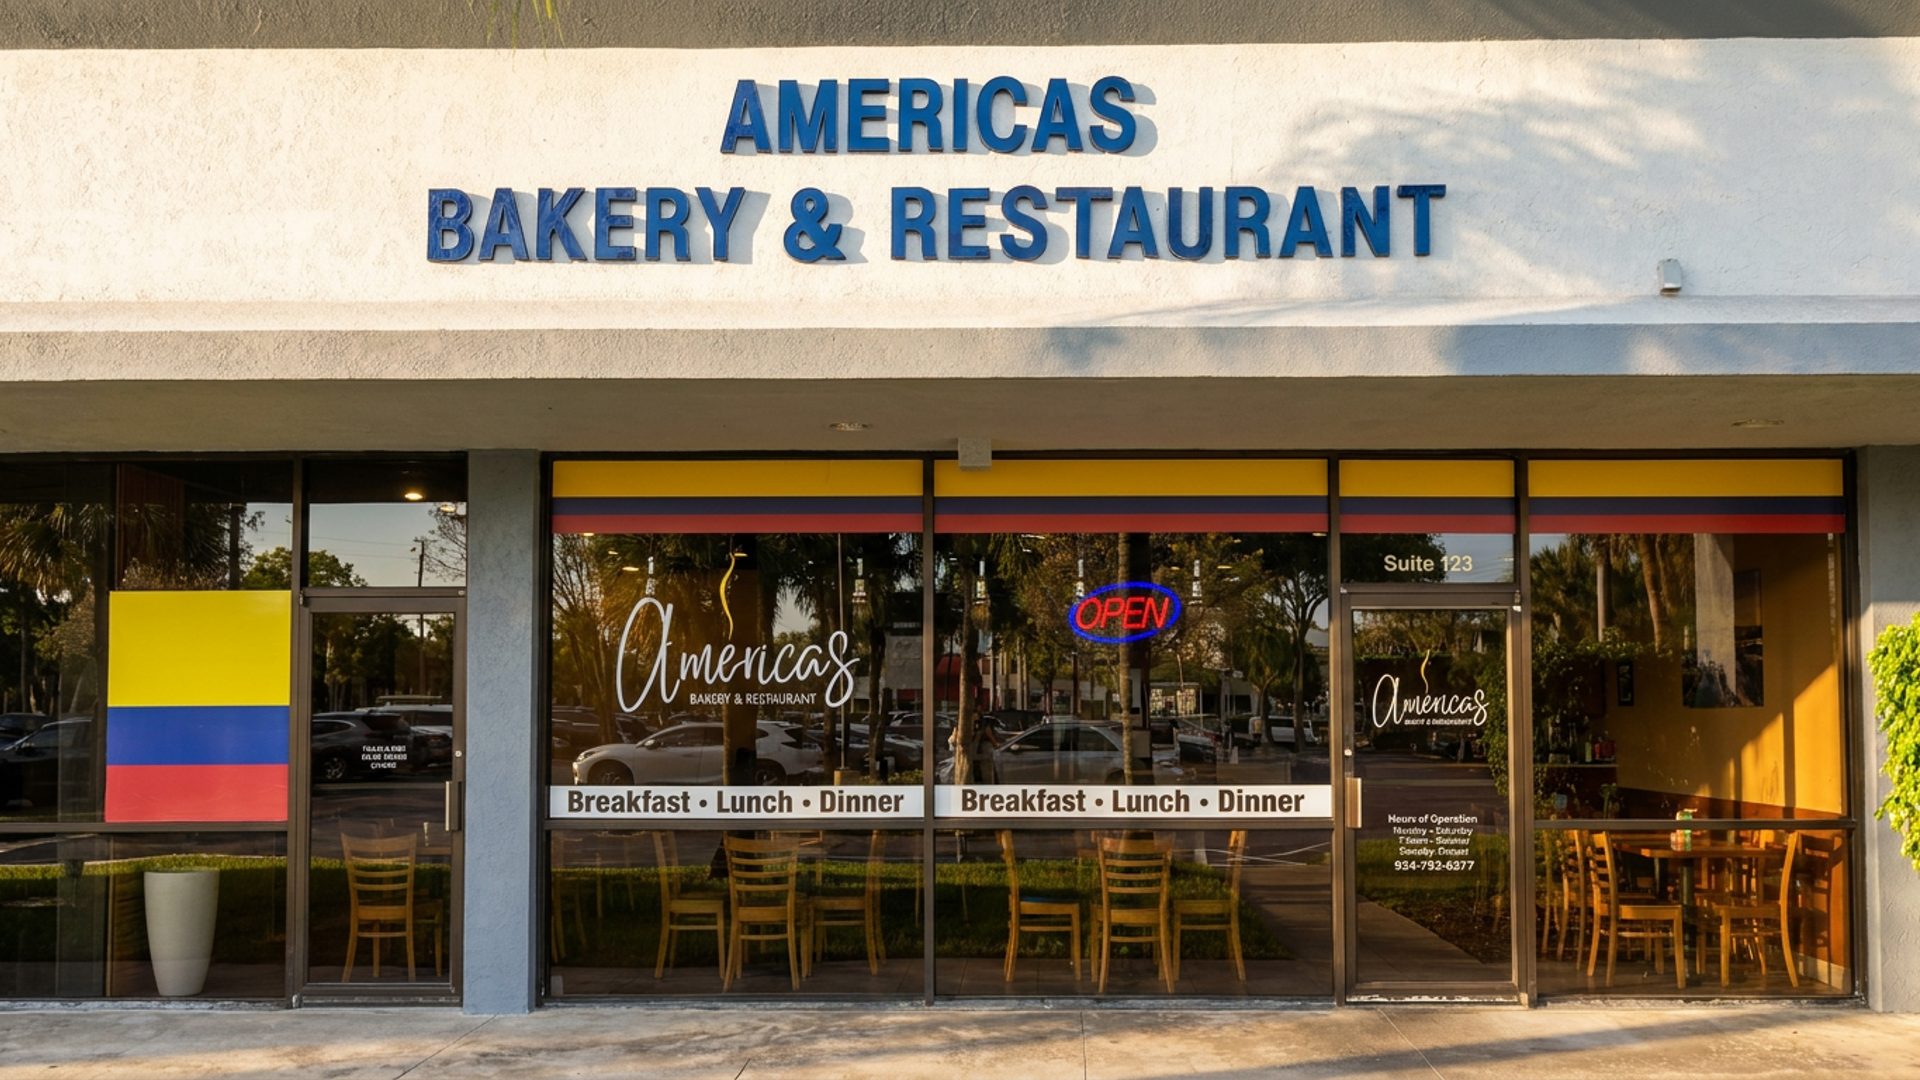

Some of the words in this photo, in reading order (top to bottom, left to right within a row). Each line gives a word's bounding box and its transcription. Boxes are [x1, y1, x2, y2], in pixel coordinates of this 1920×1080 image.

[721, 76, 1140, 154] AMERICAS
[428, 186, 746, 263] BAKERY
[783, 188, 846, 262] &
[891, 183, 1447, 260] RESTAURANT
[1384, 554, 1434, 573] Suite
[1440, 554, 1474, 573] 123
[1075, 595, 1172, 632] OPEN
[734, 692, 744, 705] &
[745, 692, 817, 705] RESTAURANT
[567, 789, 691, 814] Breakfast
[716, 789, 793, 814] Lunch
[819, 789, 905, 814] Dinner
[961, 788, 1086, 813] Breakfast
[1112, 788, 1190, 813] Lunch
[1218, 788, 1306, 813] Dinner
[1418, 814, 1429, 824] of
